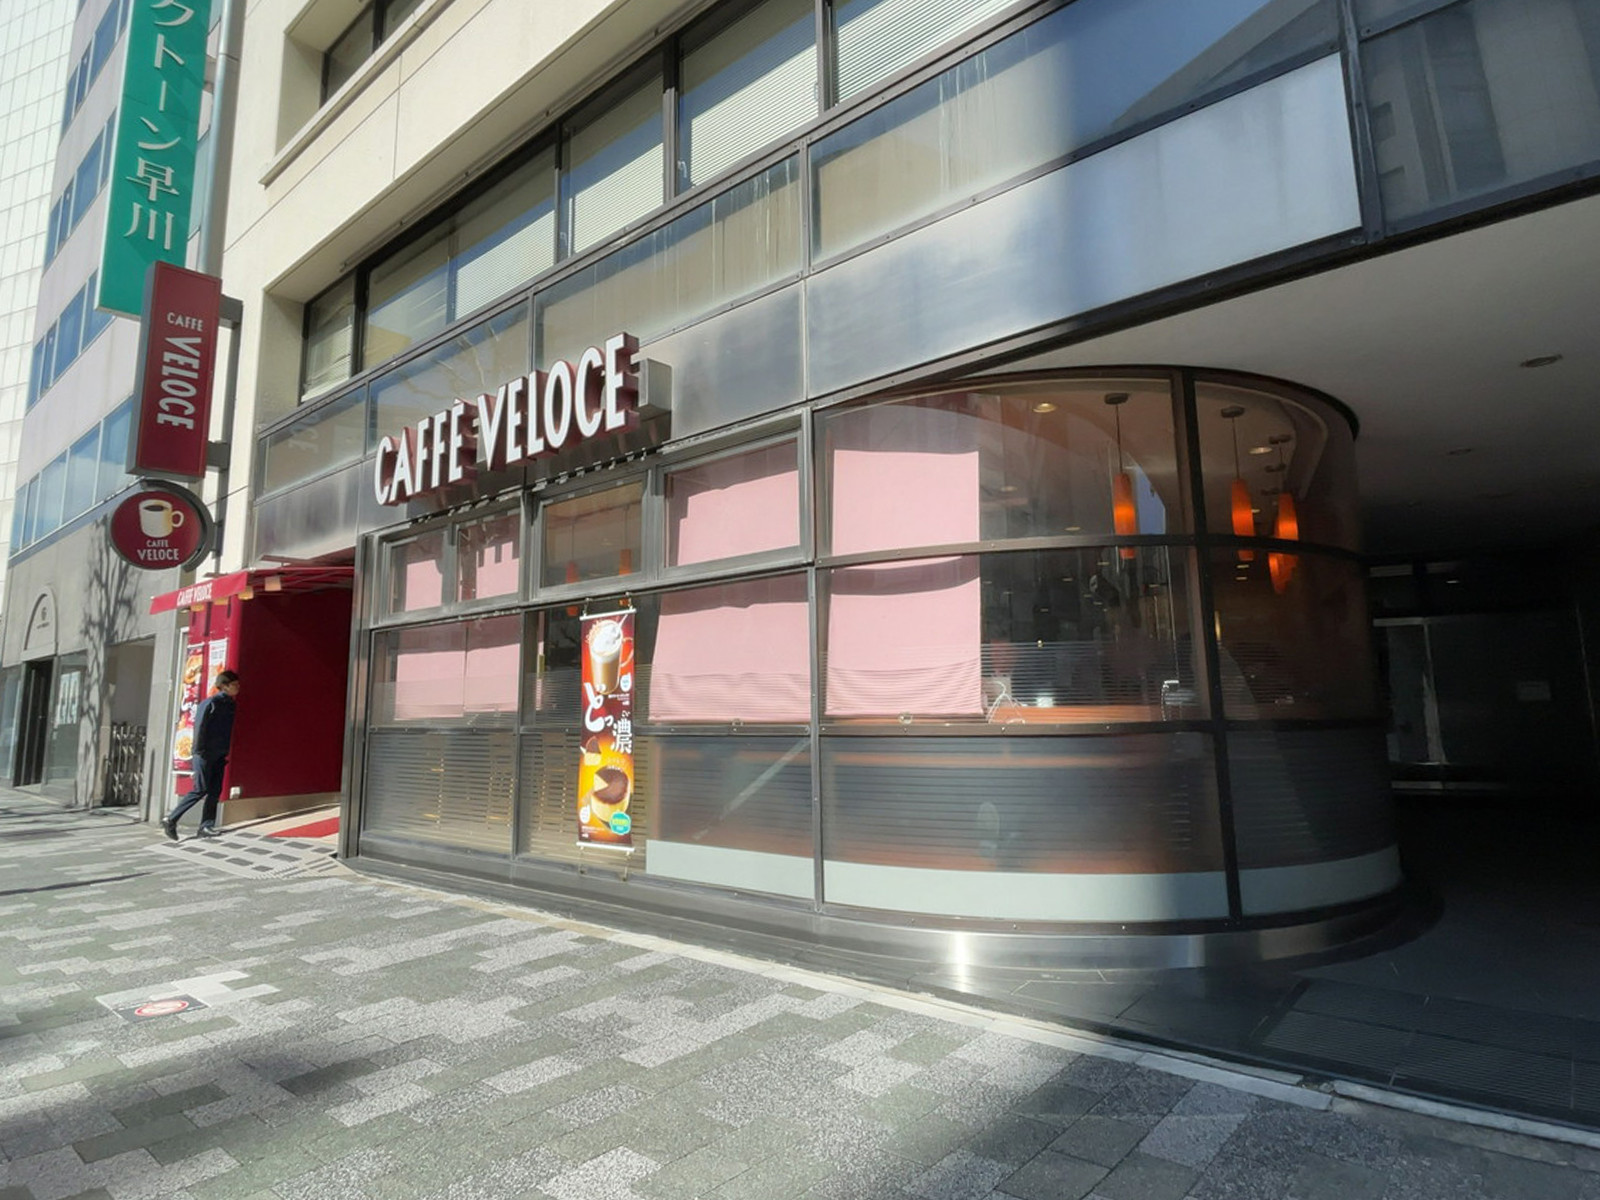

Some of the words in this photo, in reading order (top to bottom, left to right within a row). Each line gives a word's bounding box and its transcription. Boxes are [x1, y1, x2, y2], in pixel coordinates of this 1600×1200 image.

[157, 337, 202, 430] VELOCE
[477, 332, 631, 471] VELOCE
[137, 548, 179, 560] VELOCE
